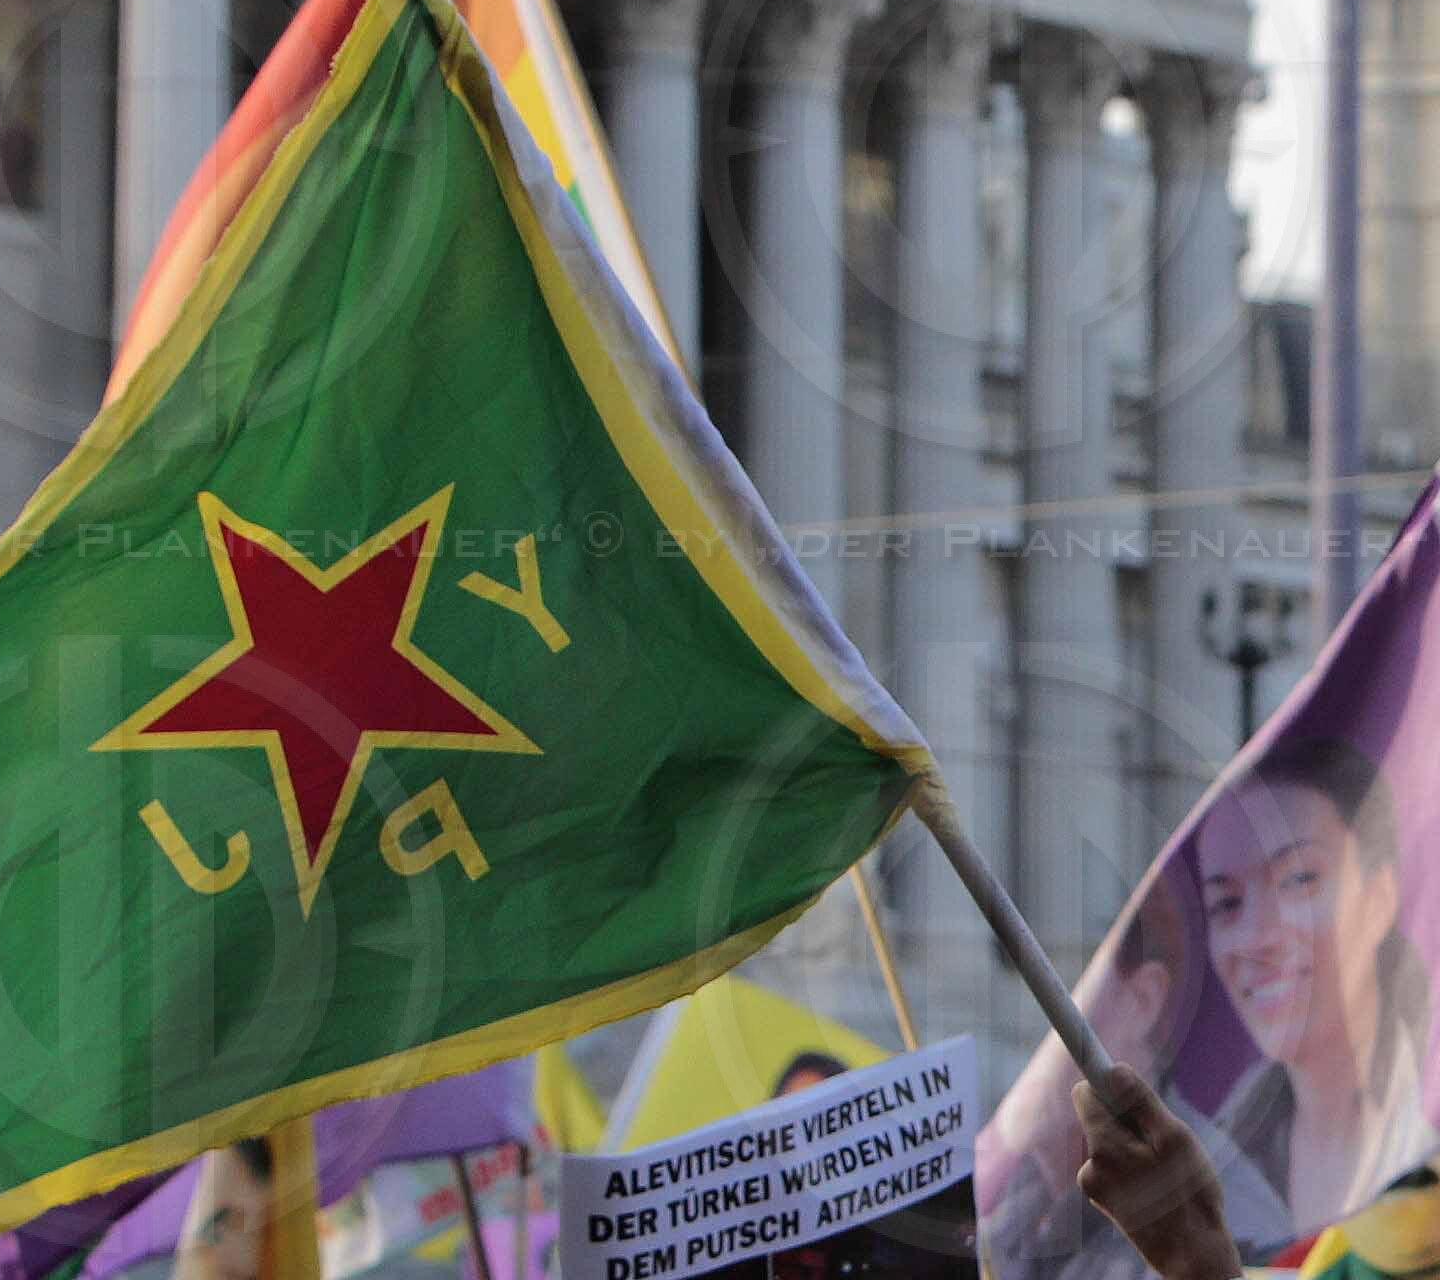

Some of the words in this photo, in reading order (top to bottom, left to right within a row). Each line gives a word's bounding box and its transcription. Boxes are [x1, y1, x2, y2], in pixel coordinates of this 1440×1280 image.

[588, 1207, 658, 1243] DER
[667, 1173, 771, 1228] TÜRKEI
[781, 1132, 894, 1195] WURDEN
[898, 1102, 963, 1152] NACH
[605, 1123, 796, 1199] ALEVITISCHE
[801, 1076, 915, 1143] VIERTELN
[920, 1063, 952, 1098] IN
[687, 1208, 800, 1266] PUTSCH
[816, 1147, 955, 1228] ATTACKIERT
